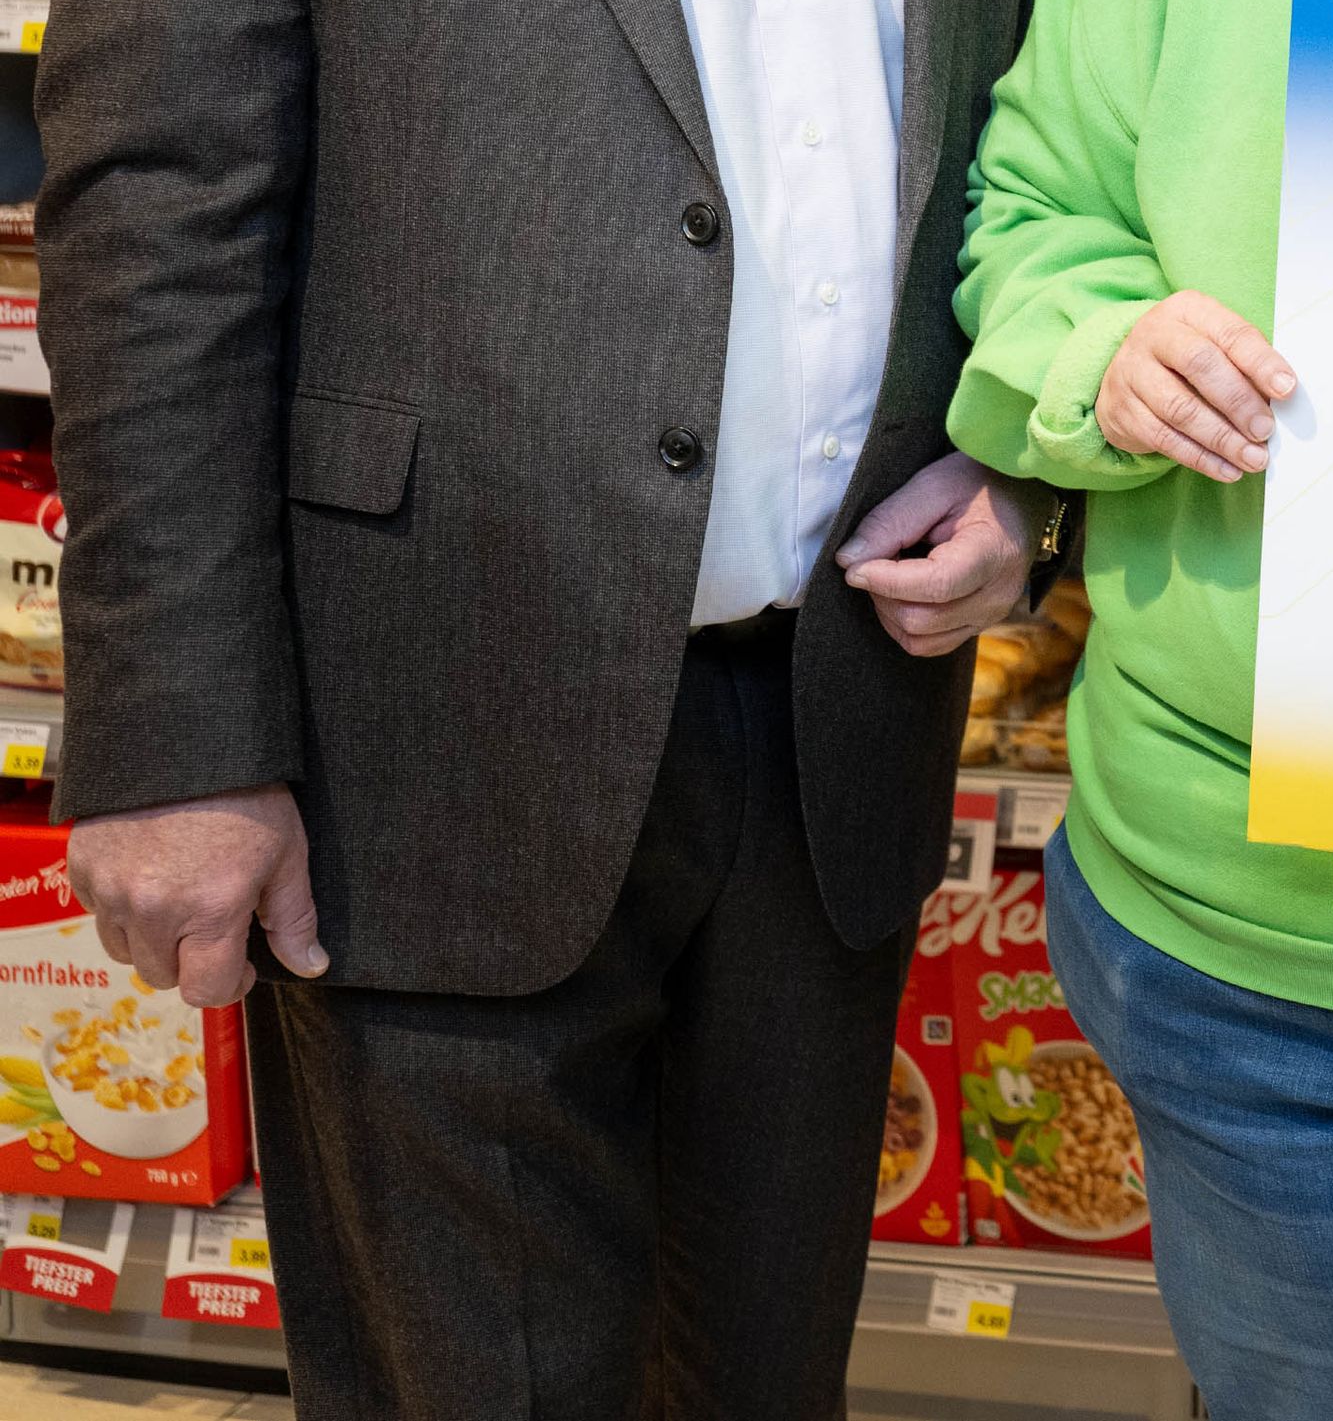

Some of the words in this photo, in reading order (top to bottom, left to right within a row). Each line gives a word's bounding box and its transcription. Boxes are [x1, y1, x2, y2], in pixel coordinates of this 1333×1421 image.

[0, 961, 110, 989] ornflakes
[25, 1253, 95, 1286] TIEFSTER
[32, 1272, 79, 1298] PREIS
[188, 1280, 262, 1304] TIEFSTER
[197, 1297, 247, 1319] PREIS
